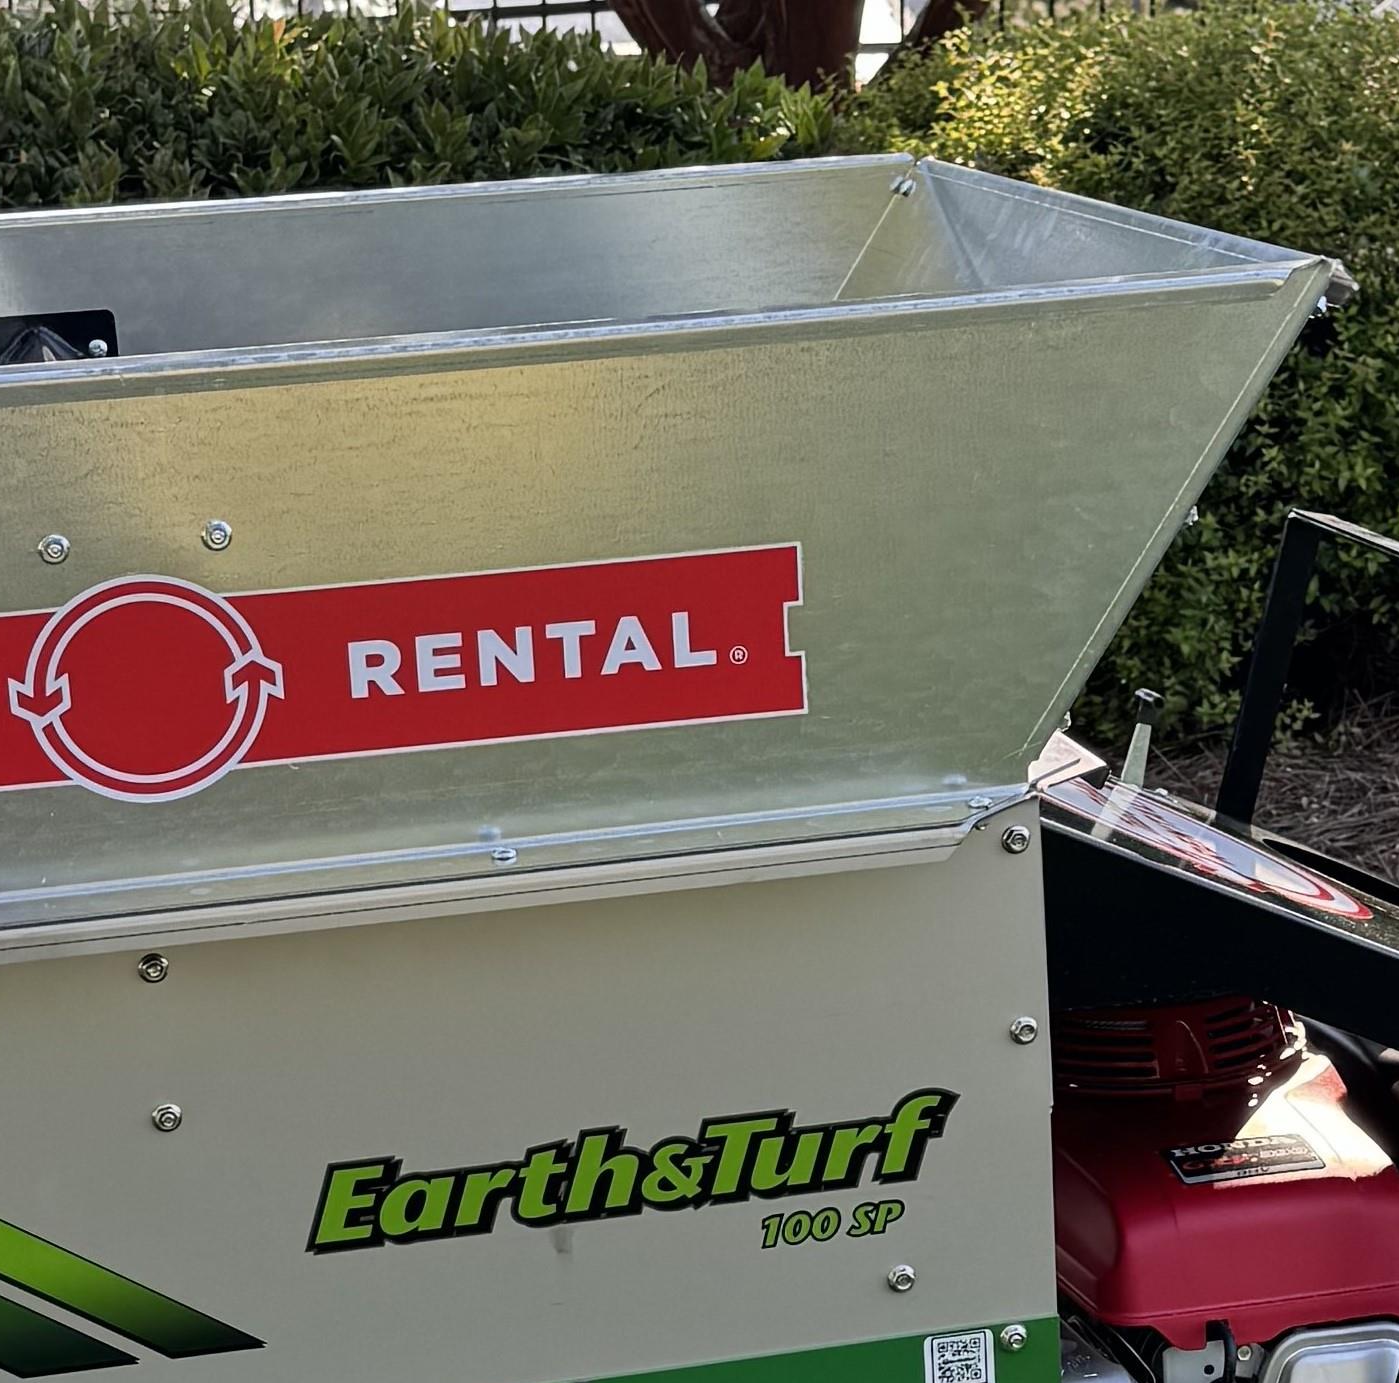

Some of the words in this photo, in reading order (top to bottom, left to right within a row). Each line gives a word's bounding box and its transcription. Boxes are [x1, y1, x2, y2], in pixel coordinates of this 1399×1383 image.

[348, 611, 718, 702] RENTAL
[1171, 1136, 1298, 1157] HONDA
[761, 1207, 841, 1249] 100
[846, 1199, 906, 1238] SP
